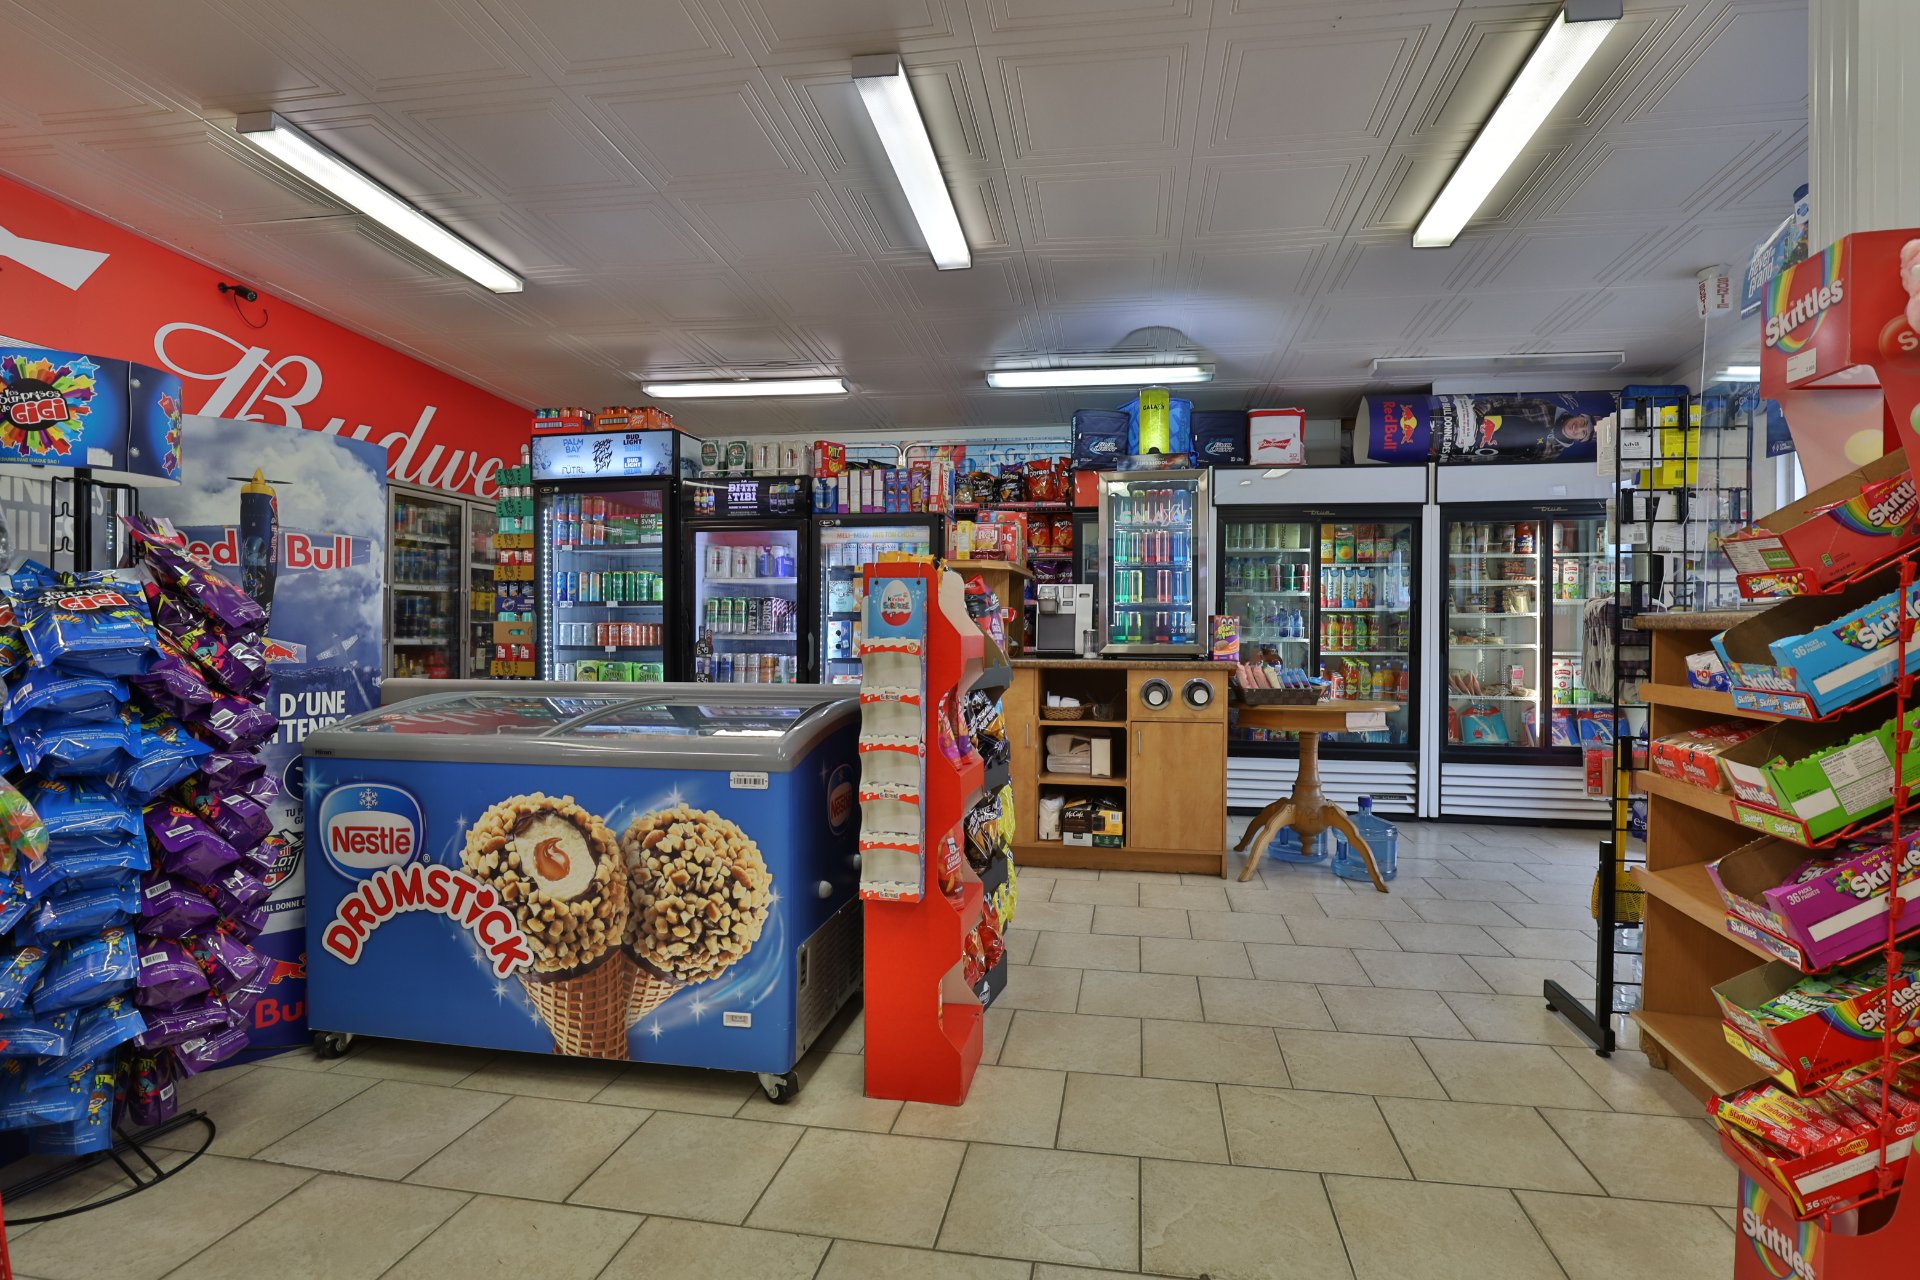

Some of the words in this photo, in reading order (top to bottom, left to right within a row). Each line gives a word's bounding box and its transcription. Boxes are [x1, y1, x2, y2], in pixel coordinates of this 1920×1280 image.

[1765, 279, 1844, 348] Skittles
[1384, 424, 1398, 450] Bull
[828, 445, 841, 458] RITZ
[1119, 503, 1187, 527] GALAXY
[285, 532, 353, 570] Bull
[1750, 578, 1776, 594] Skittles
[1791, 646, 1808, 659] 36
[1741, 673, 1796, 692] Skittles
[279, 690, 346, 718] D'UNE
[1737, 695, 1757, 704] Skittles
[1760, 698, 1780, 707] Skittles
[1783, 701, 1806, 710] Skittles
[1733, 783, 1778, 806] Skittles
[1743, 813, 1763, 824] Skittles
[1774, 823, 1796, 835] Skittles
[332, 826, 411, 855] Nestlé
[275, 900, 300, 911] DONNE
[1786, 892, 1801, 906] 36
[325, 864, 531, 975] DRUMSTICK
[1730, 920, 1758, 940] Skittles
[1805, 1199, 1820, 1211] 36
[1741, 1205, 1817, 1280] Skittles
